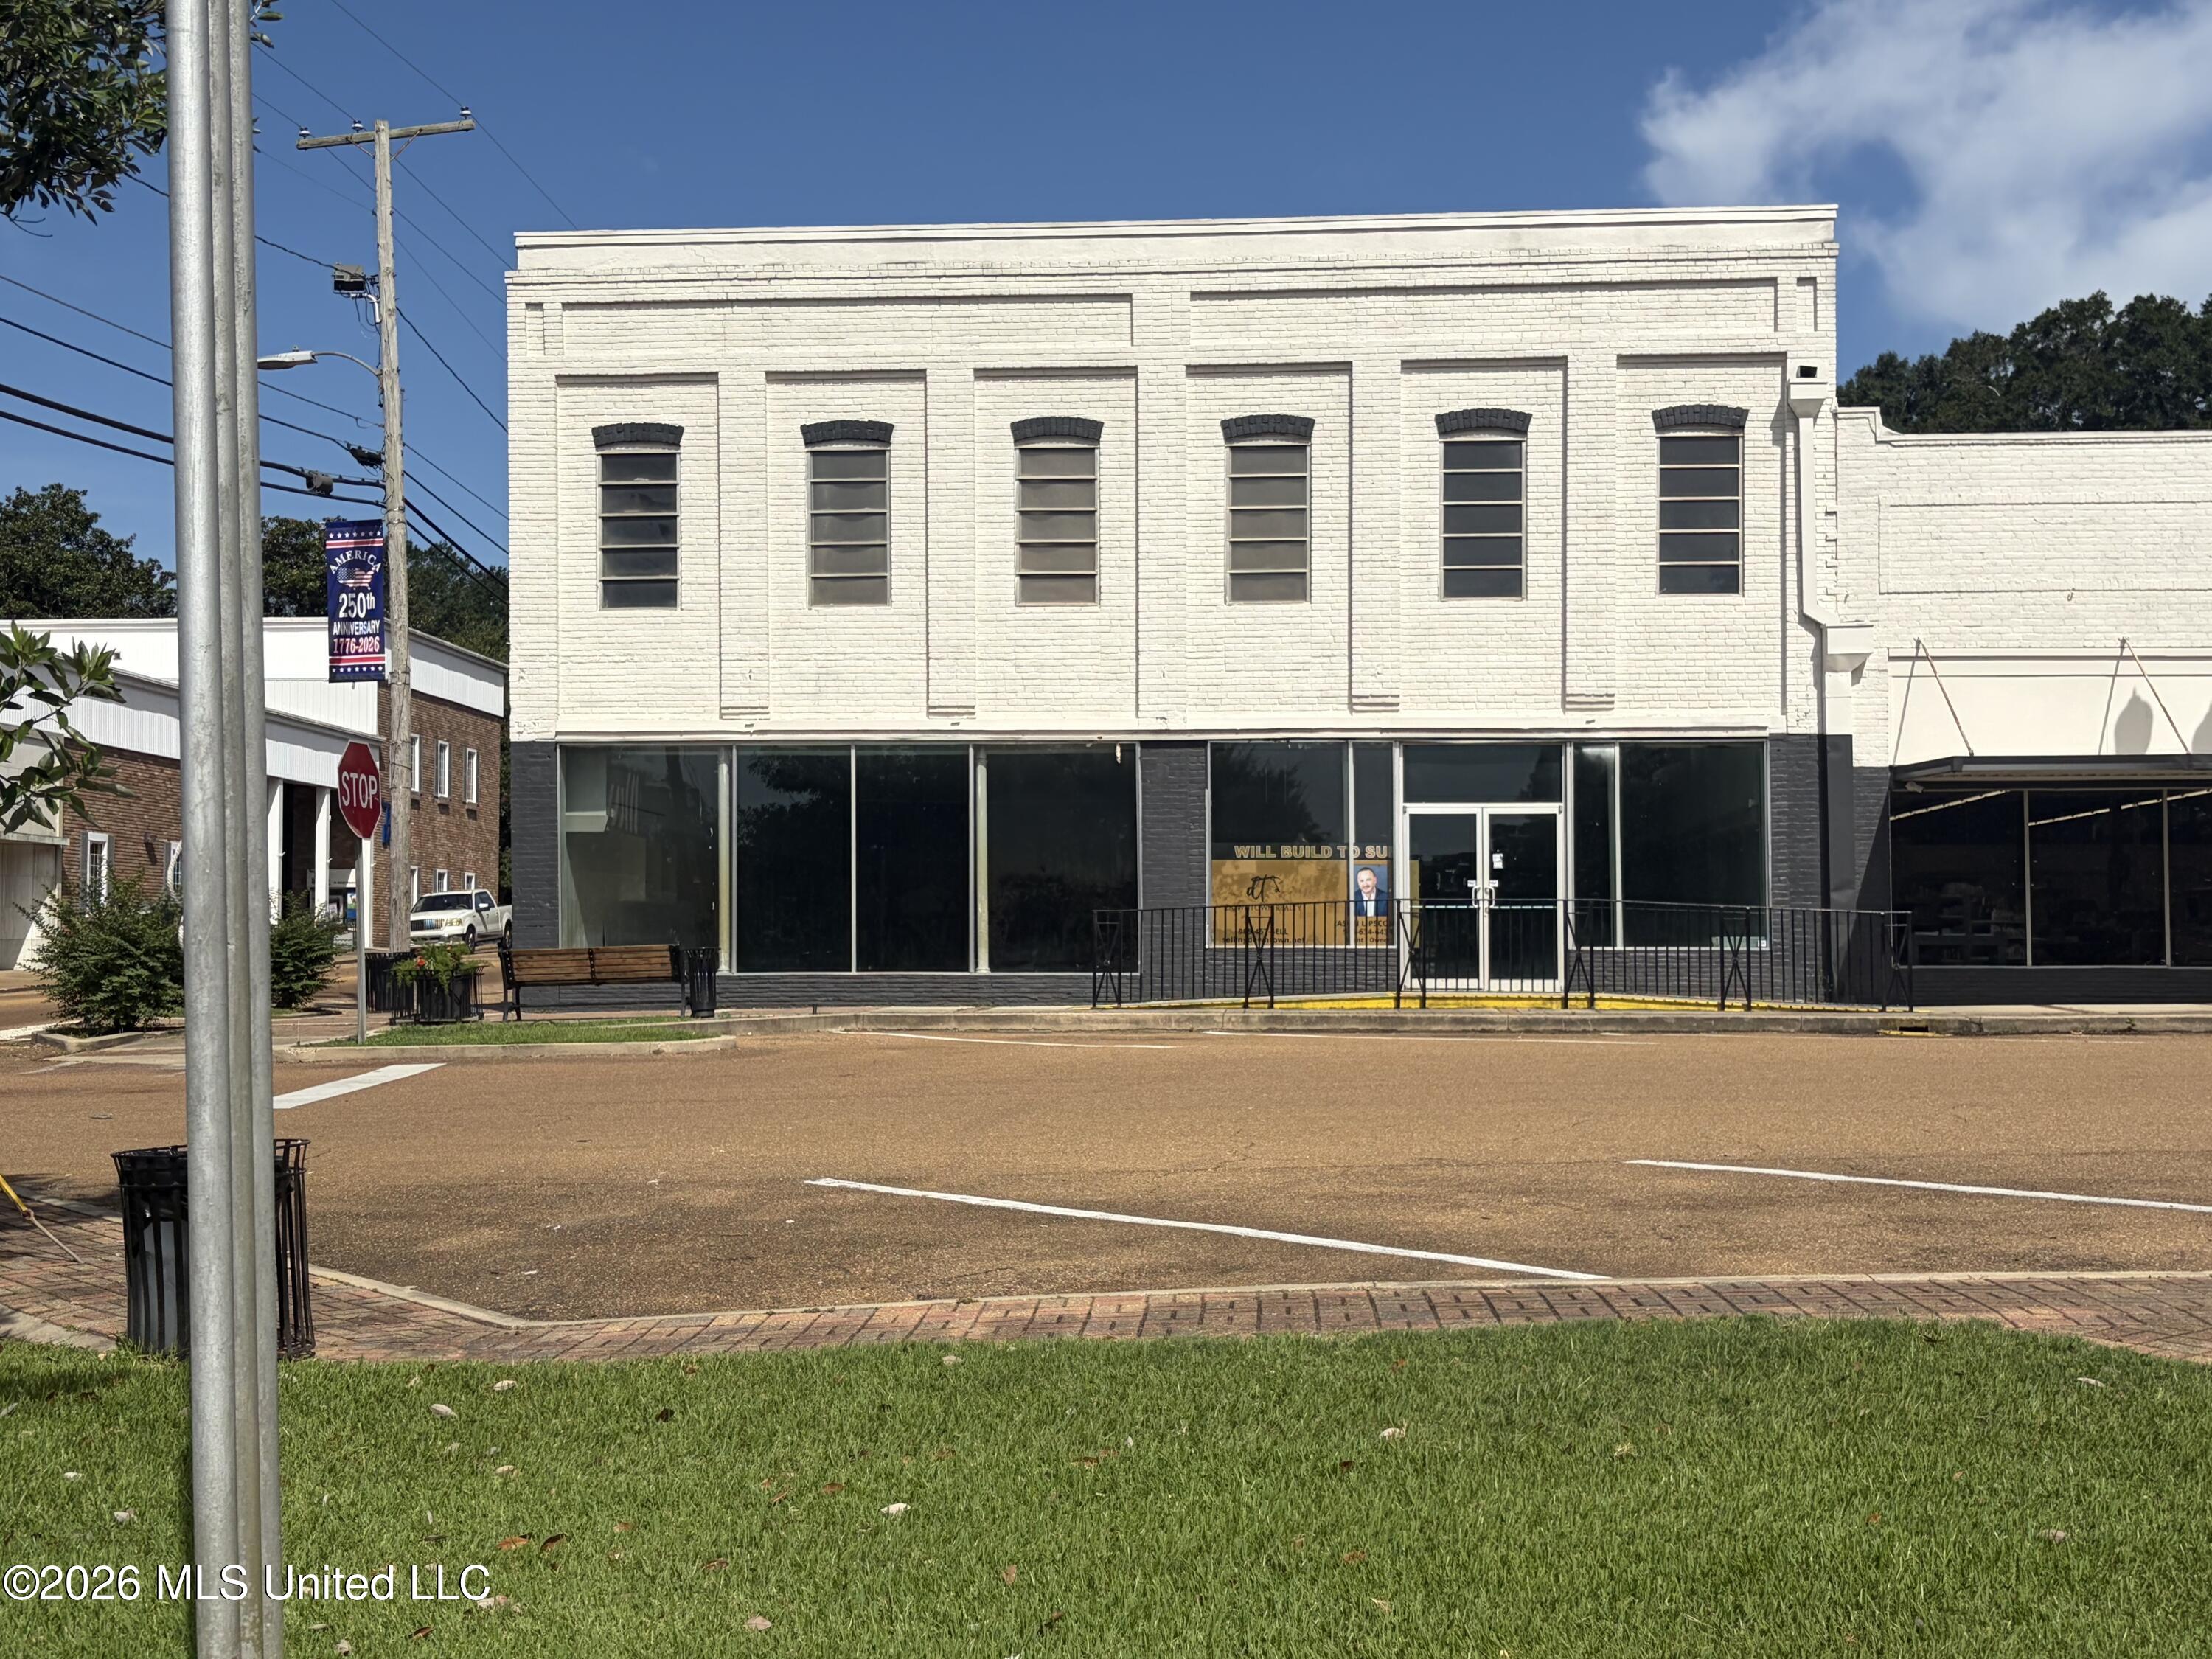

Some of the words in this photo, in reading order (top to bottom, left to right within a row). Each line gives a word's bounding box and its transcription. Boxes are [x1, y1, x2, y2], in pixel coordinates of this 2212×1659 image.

[330, 549, 381, 575] AMERICA
[338, 591, 375, 619] 250th
[333, 619, 380, 636] ANNIVERSARY
[333, 636, 380, 655] 1776-2026
[341, 771, 378, 809] STOP
[1234, 846, 1276, 859] WILL
[1281, 846, 1332, 859] BUILD
